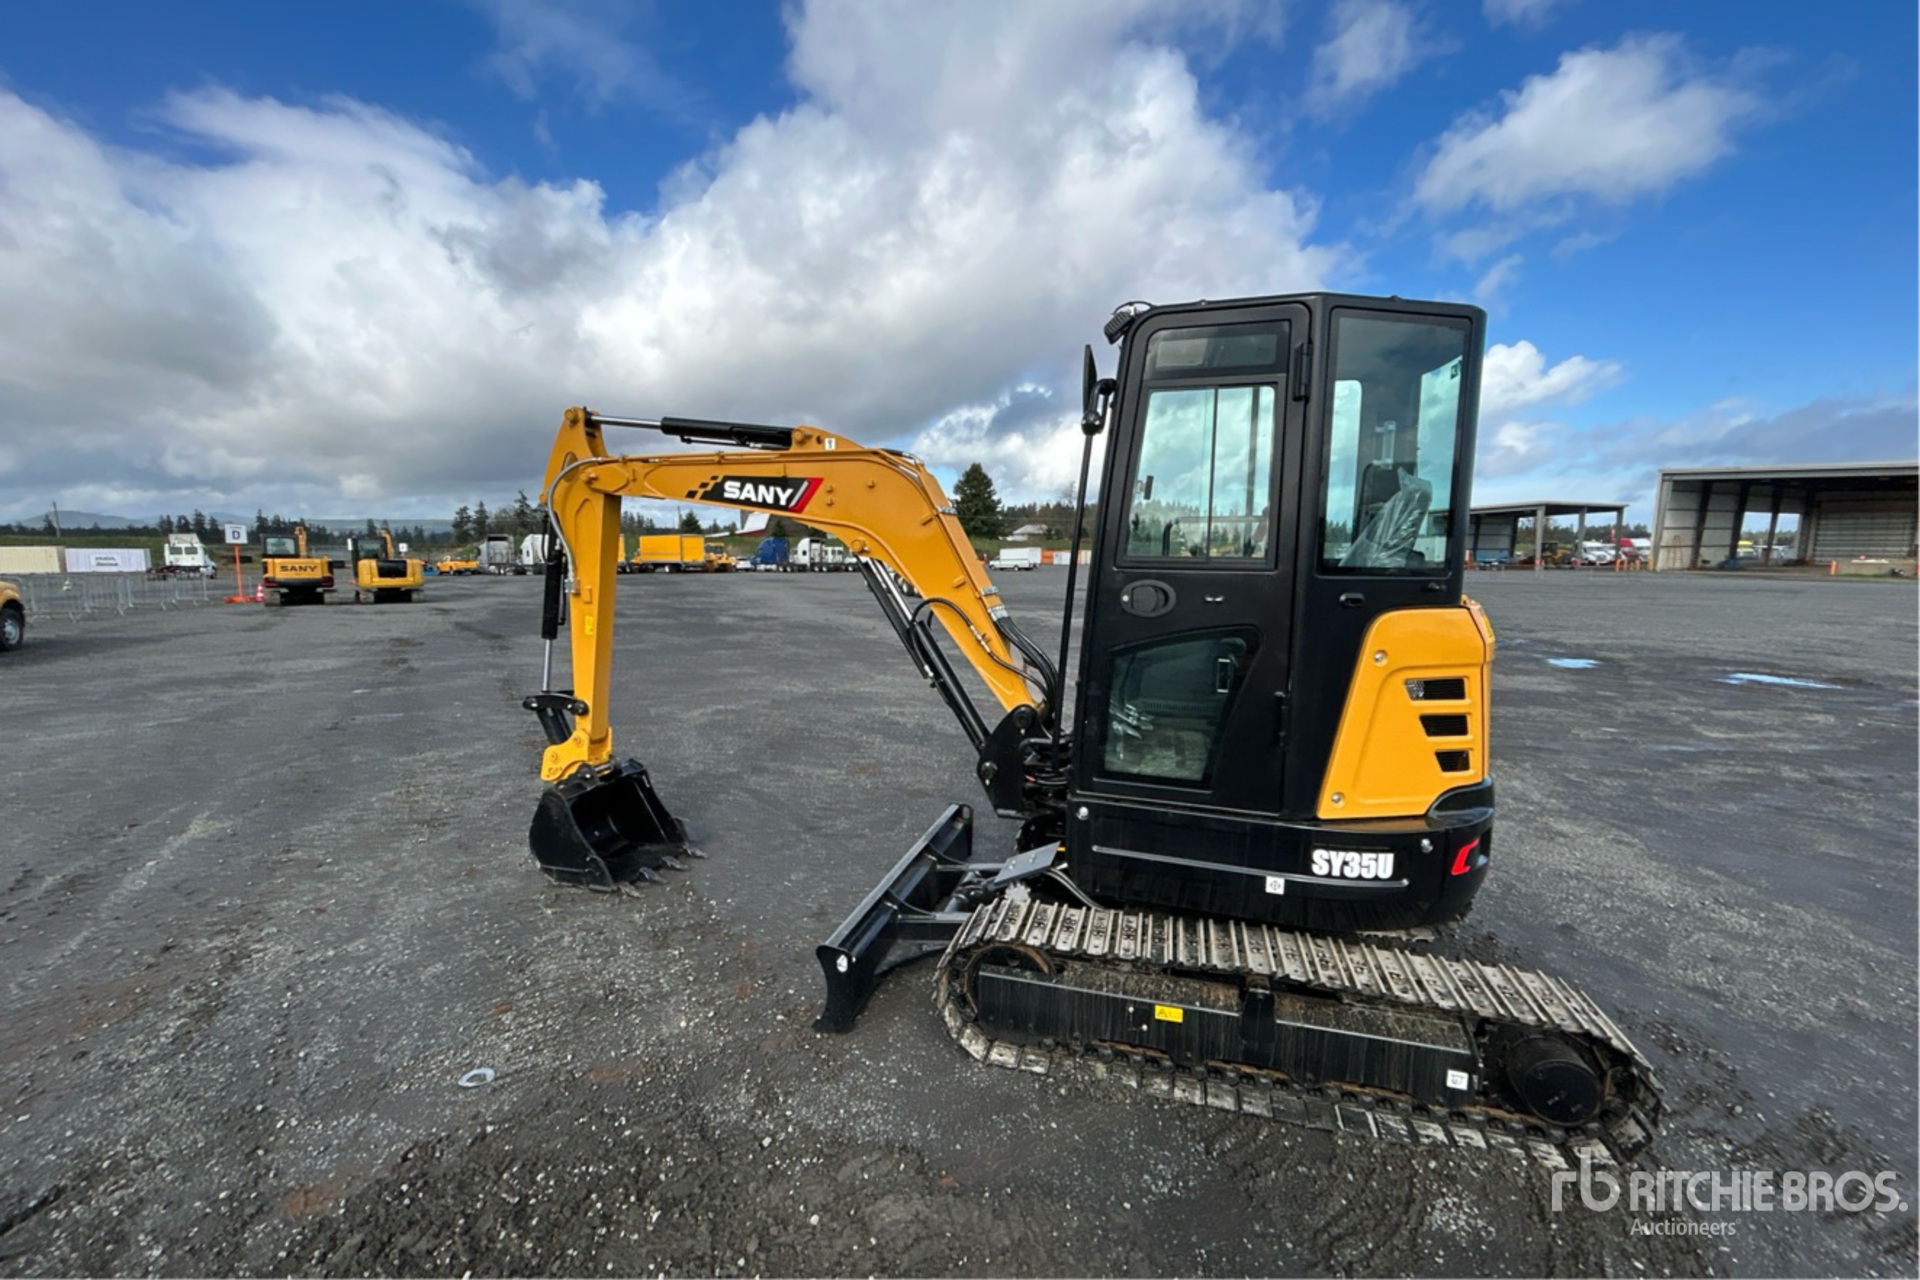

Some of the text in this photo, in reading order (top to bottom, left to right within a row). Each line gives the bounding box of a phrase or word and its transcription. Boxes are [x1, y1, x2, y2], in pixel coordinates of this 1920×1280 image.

[723, 481, 794, 505] SANY
[231, 530, 241, 540] D
[1311, 849, 1394, 879] SY35U
